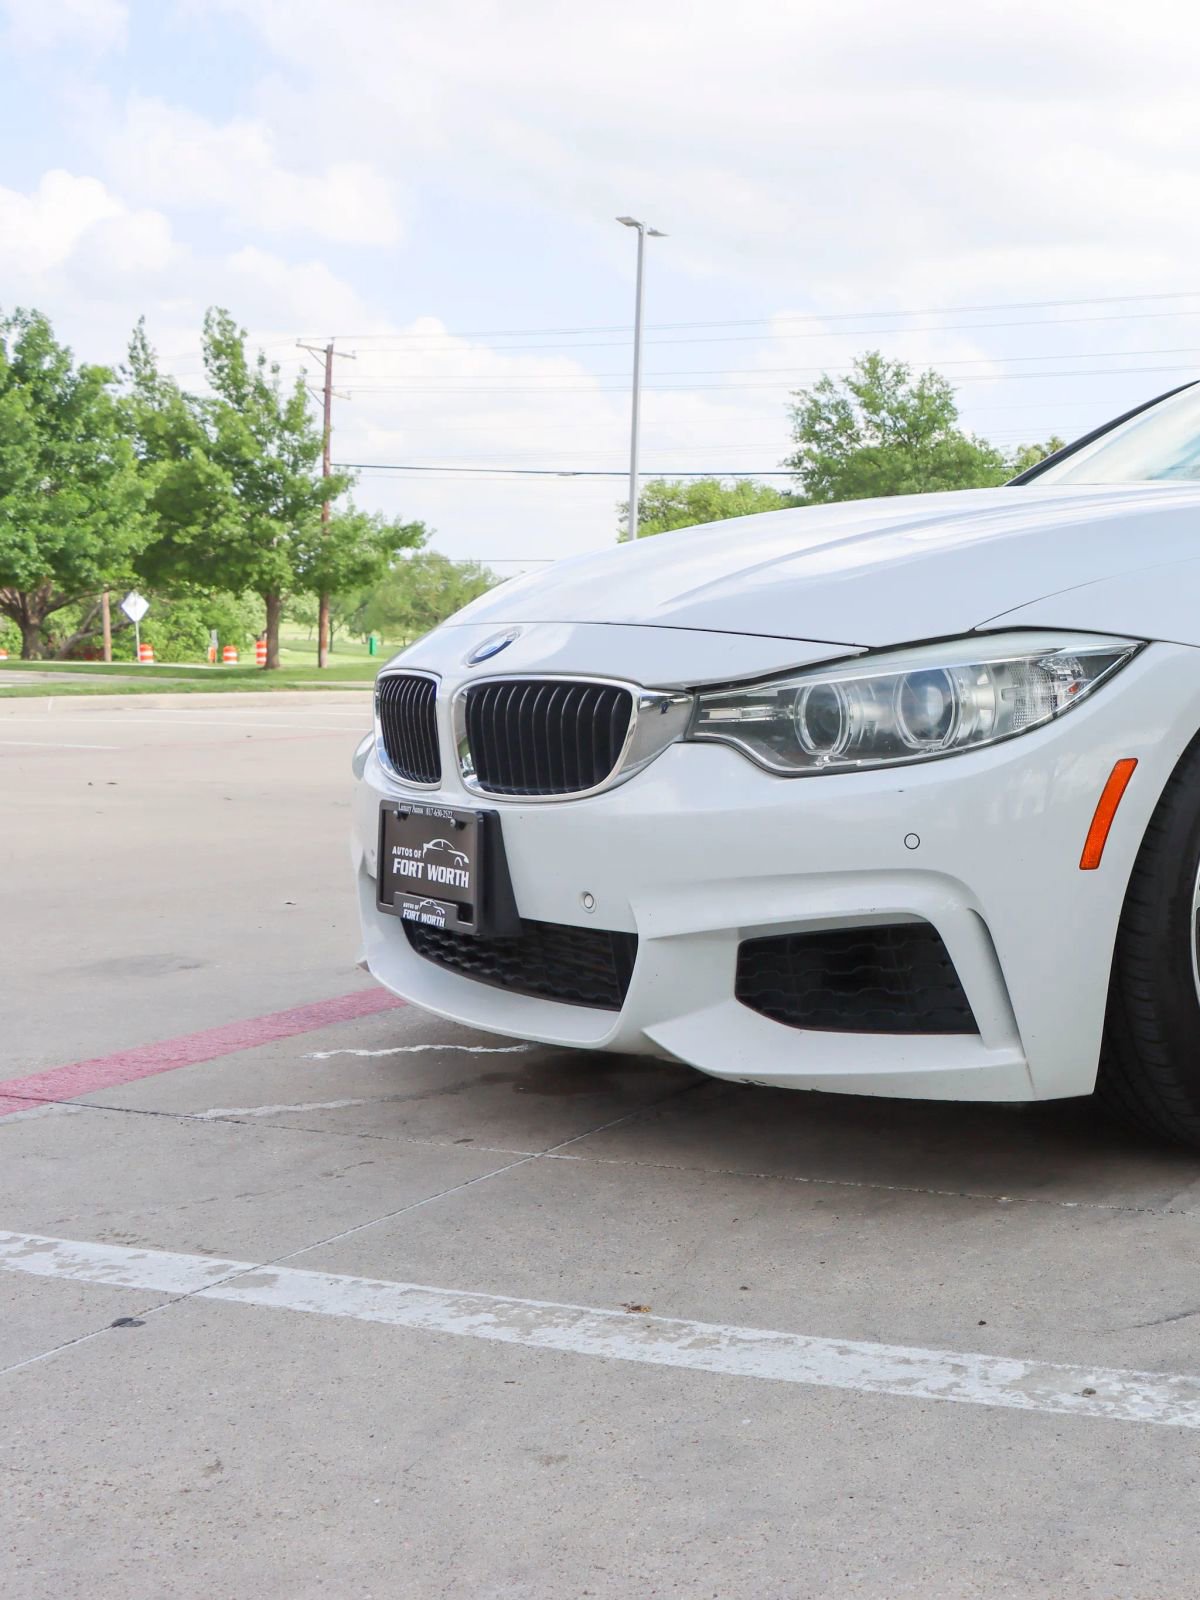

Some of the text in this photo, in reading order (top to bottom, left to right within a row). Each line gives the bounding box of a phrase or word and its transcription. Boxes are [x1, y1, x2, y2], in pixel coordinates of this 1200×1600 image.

[392, 846, 422, 859] AUTOS OF
[392, 857, 470, 889] FORT WORTH
[402, 908, 446, 928] FORT WORTH
